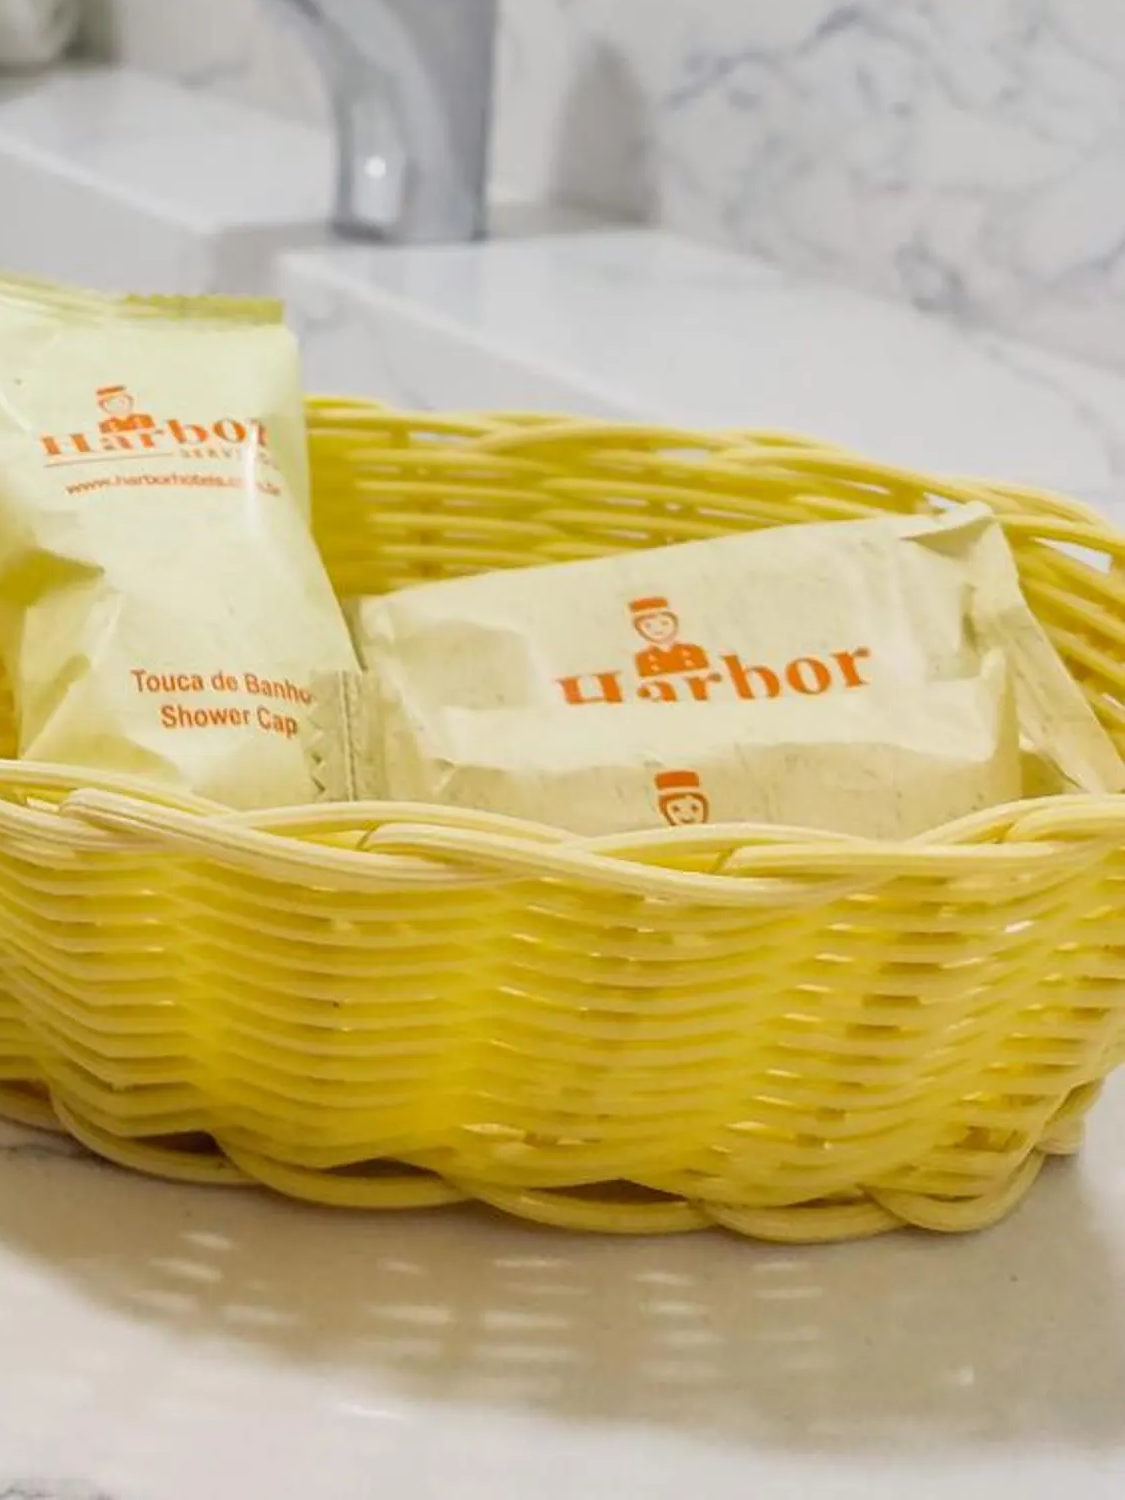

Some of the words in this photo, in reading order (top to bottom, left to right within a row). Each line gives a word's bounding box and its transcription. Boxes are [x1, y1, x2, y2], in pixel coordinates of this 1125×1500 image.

[130, 668, 204, 693] Touca
[210, 670, 238, 692] de
[244, 673, 312, 704] Banho
[160, 704, 251, 729] Shower
[256, 706, 298, 739] Cap
